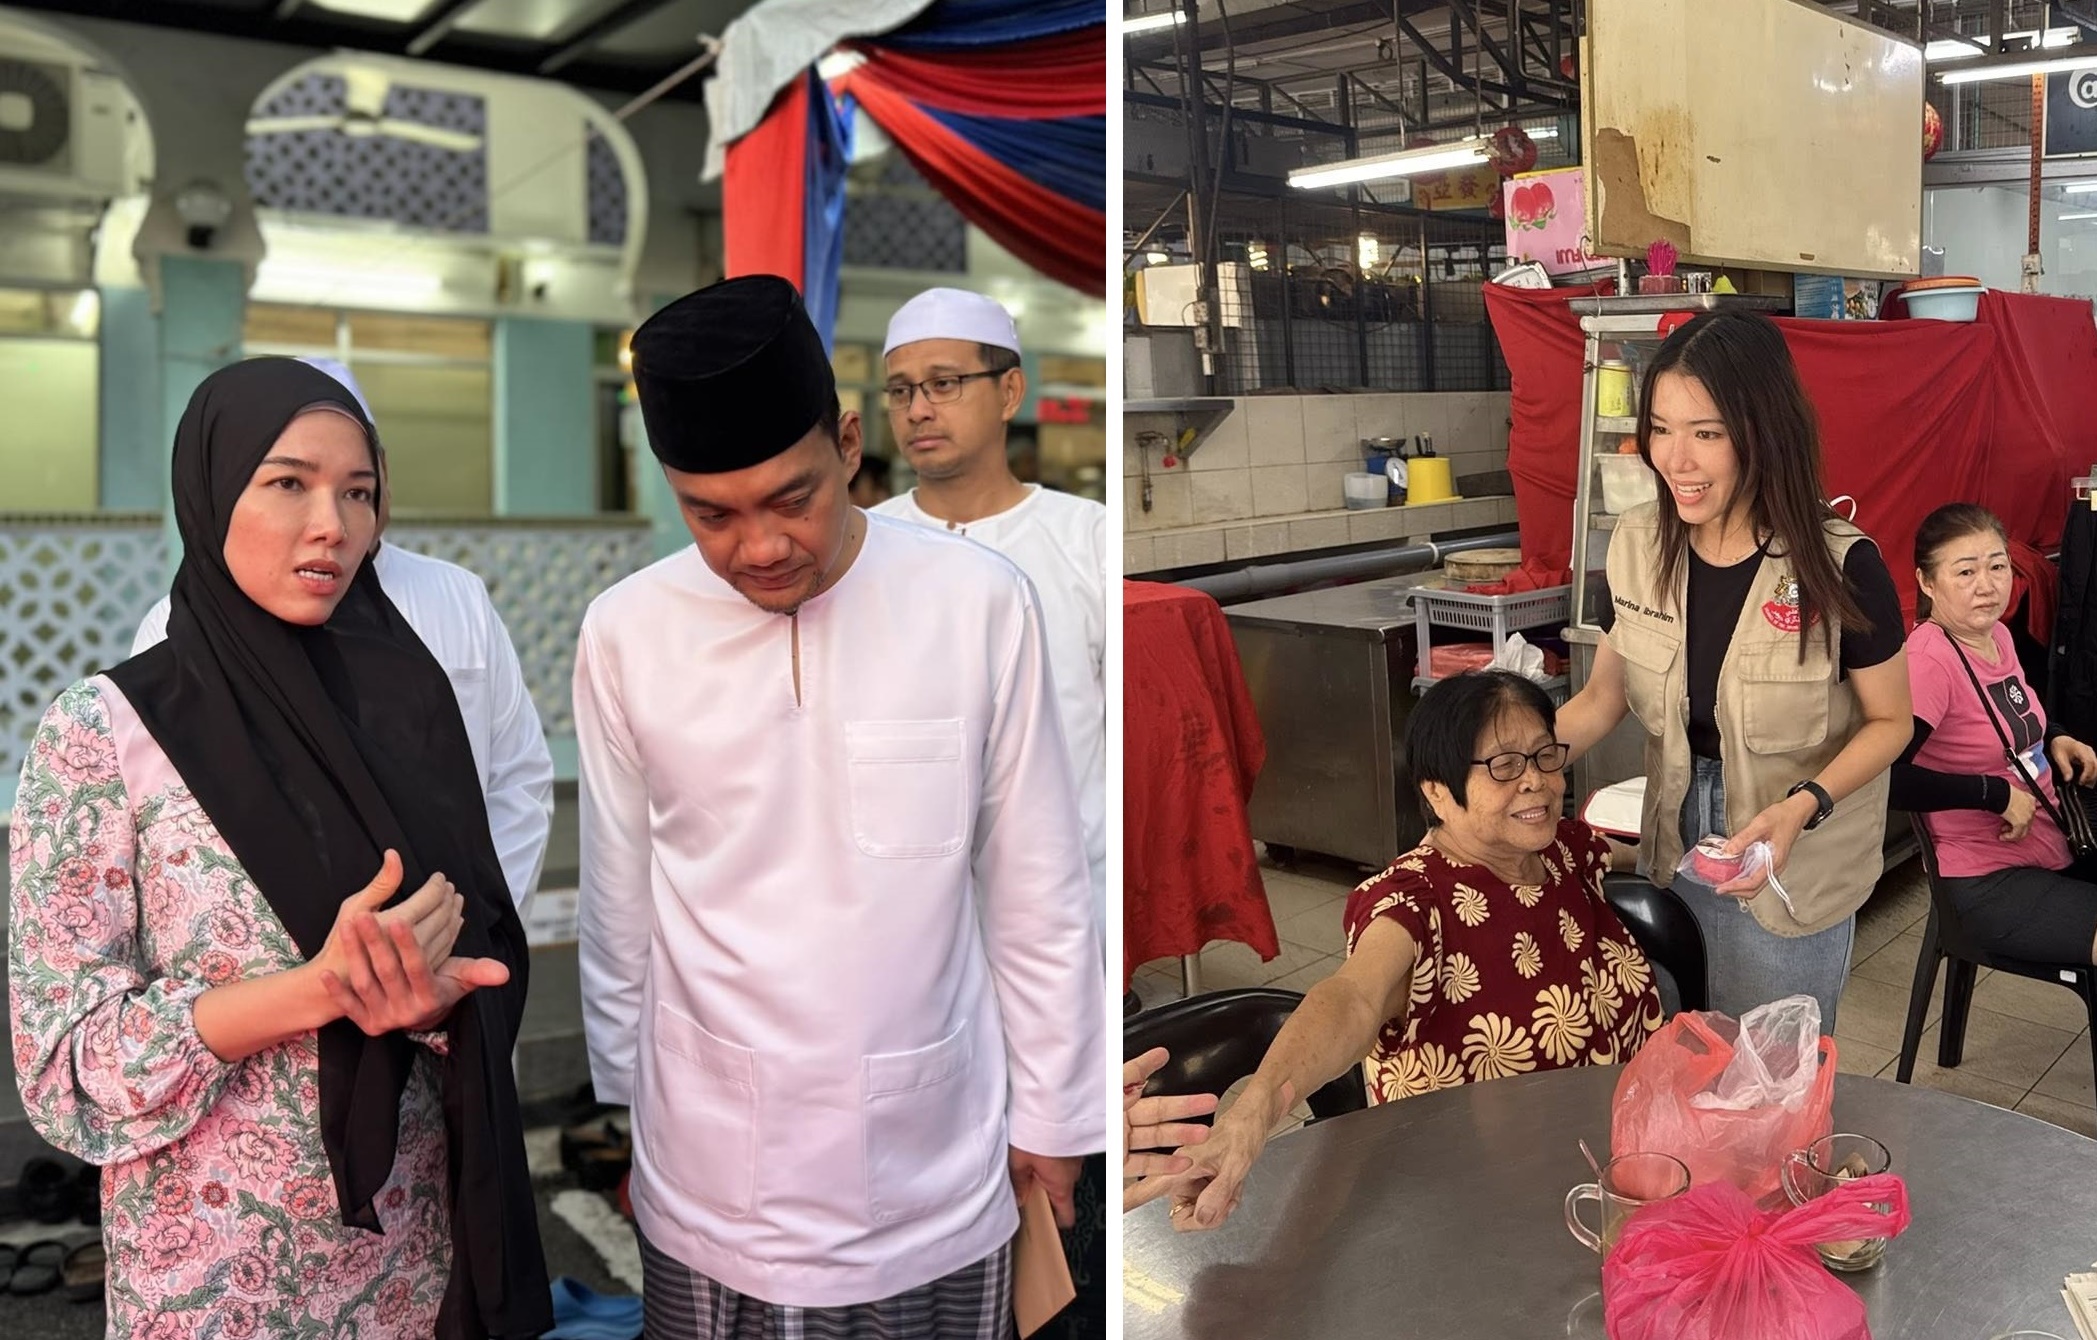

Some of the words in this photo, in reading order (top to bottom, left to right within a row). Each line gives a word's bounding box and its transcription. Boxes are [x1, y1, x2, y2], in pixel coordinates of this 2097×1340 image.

[1555, 246, 1582, 265] FUJI
[1614, 595, 1640, 612] Marina
[1643, 607, 1674, 623] Ibrahim
